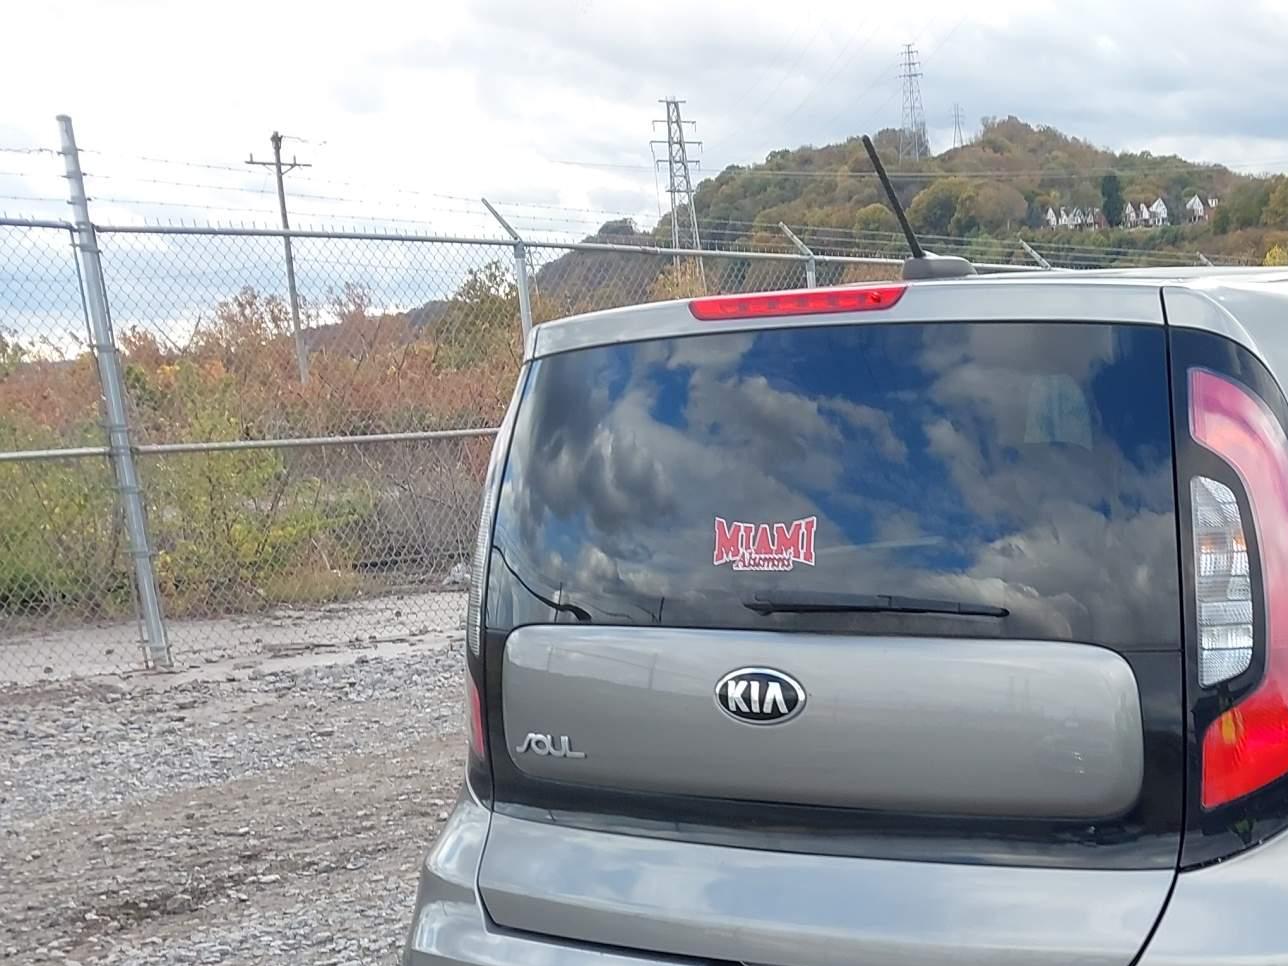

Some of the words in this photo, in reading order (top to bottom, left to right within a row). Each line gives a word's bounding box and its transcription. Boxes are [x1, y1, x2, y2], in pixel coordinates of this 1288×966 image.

[714, 516, 816, 566] MIAMI
[727, 680, 789, 715] KIA
[516, 732, 586, 759] SOUL
